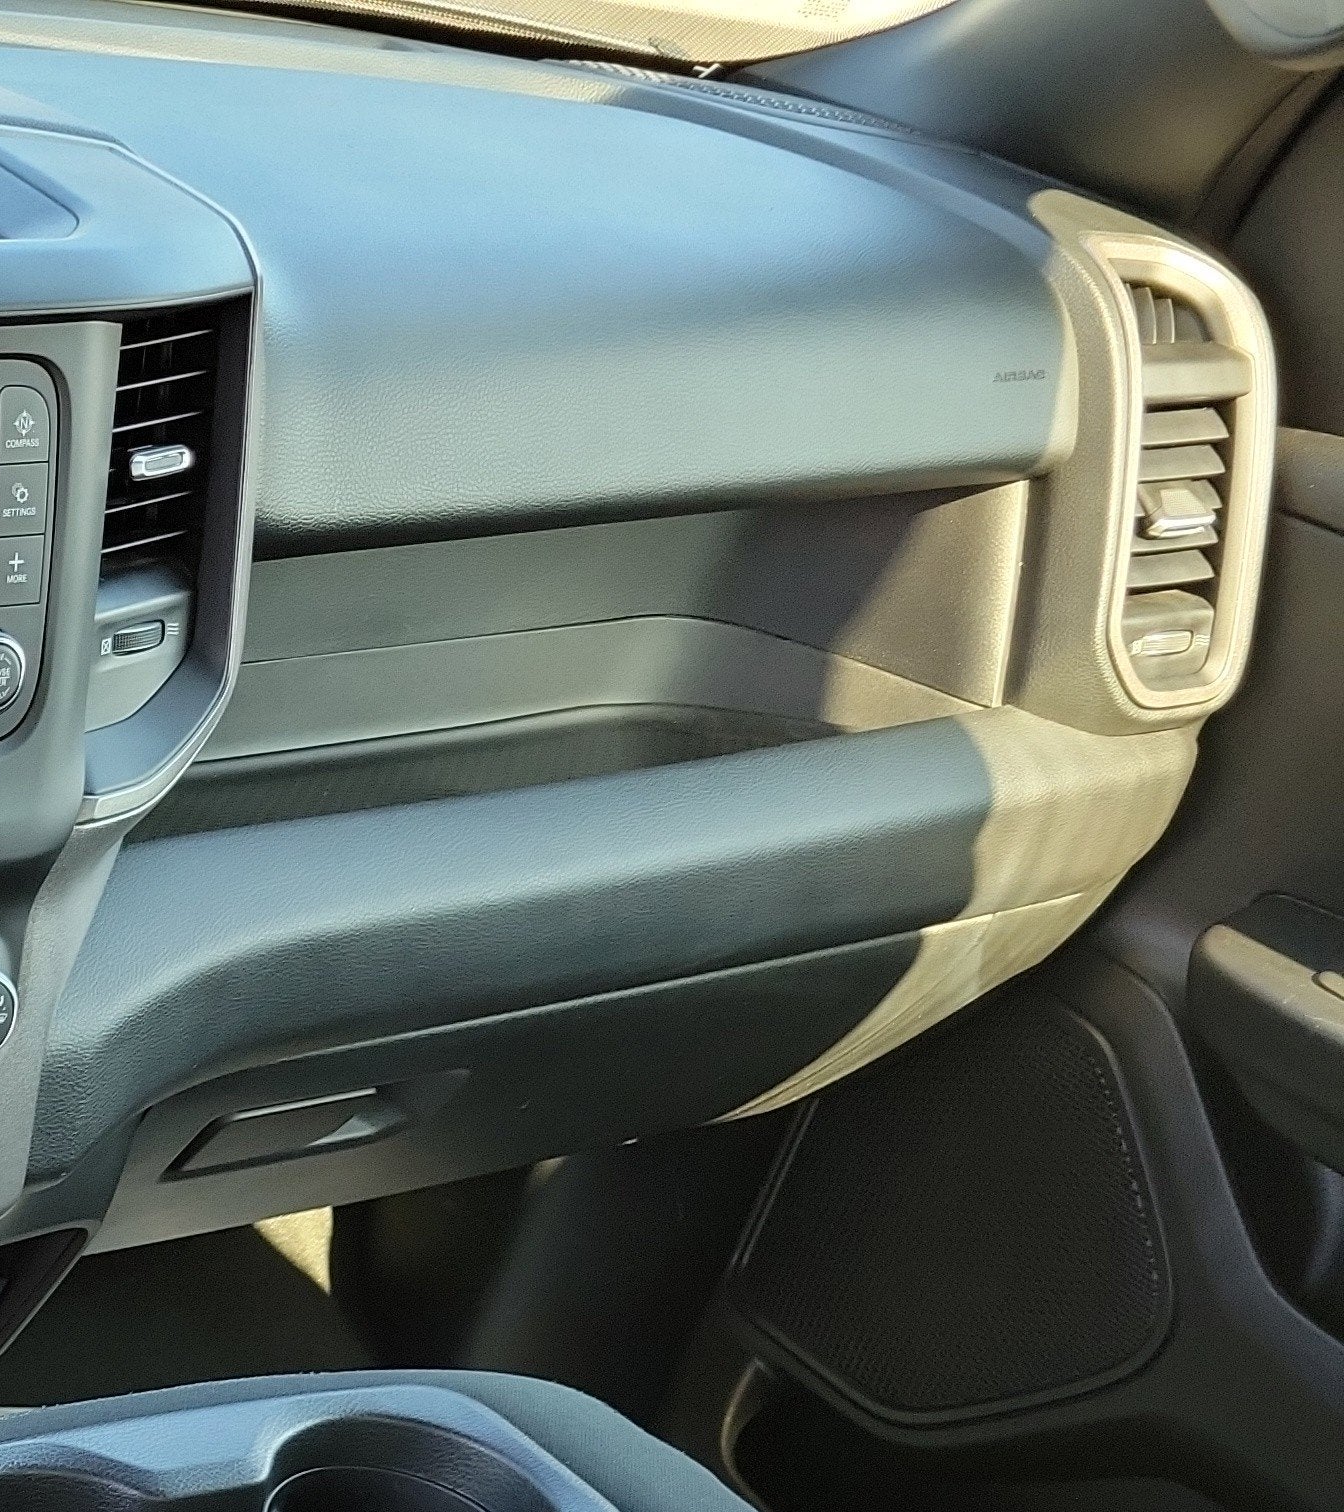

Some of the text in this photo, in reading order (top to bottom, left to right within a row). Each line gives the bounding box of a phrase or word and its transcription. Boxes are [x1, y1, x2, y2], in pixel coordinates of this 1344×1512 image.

[5, 438, 39, 448] COMPASS
[2, 507, 36, 517] SETTINGS
[6, 574, 27, 584] MORE
